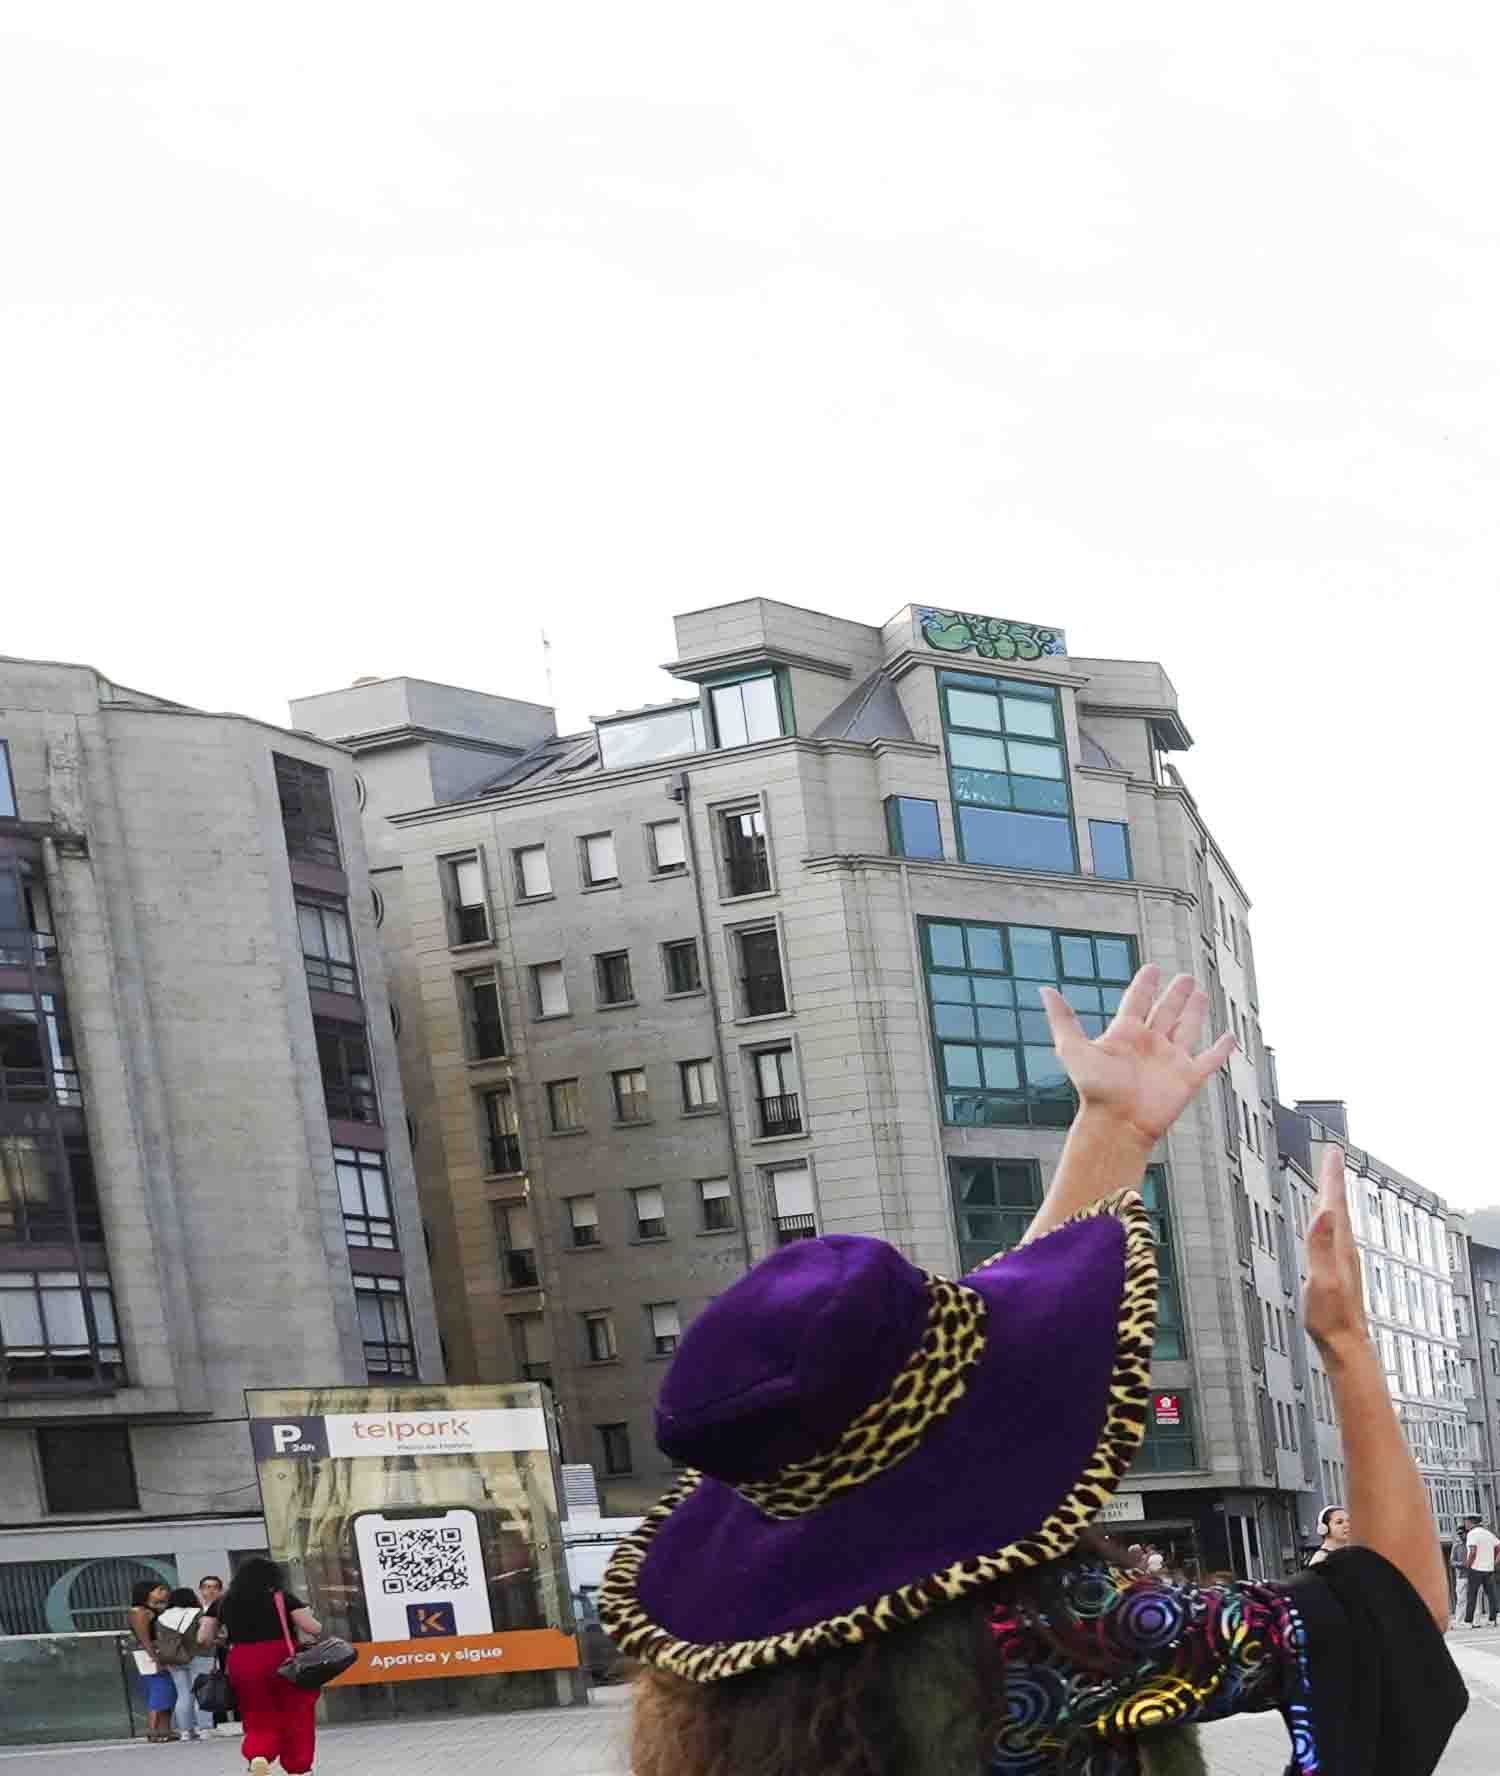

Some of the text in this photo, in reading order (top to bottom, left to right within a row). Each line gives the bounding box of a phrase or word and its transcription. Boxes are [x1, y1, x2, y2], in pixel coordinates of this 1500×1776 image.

[271, 1424, 302, 1453] P
[352, 1417, 470, 1441] telpark
[369, 1646, 503, 1669] Aparca y sigue
